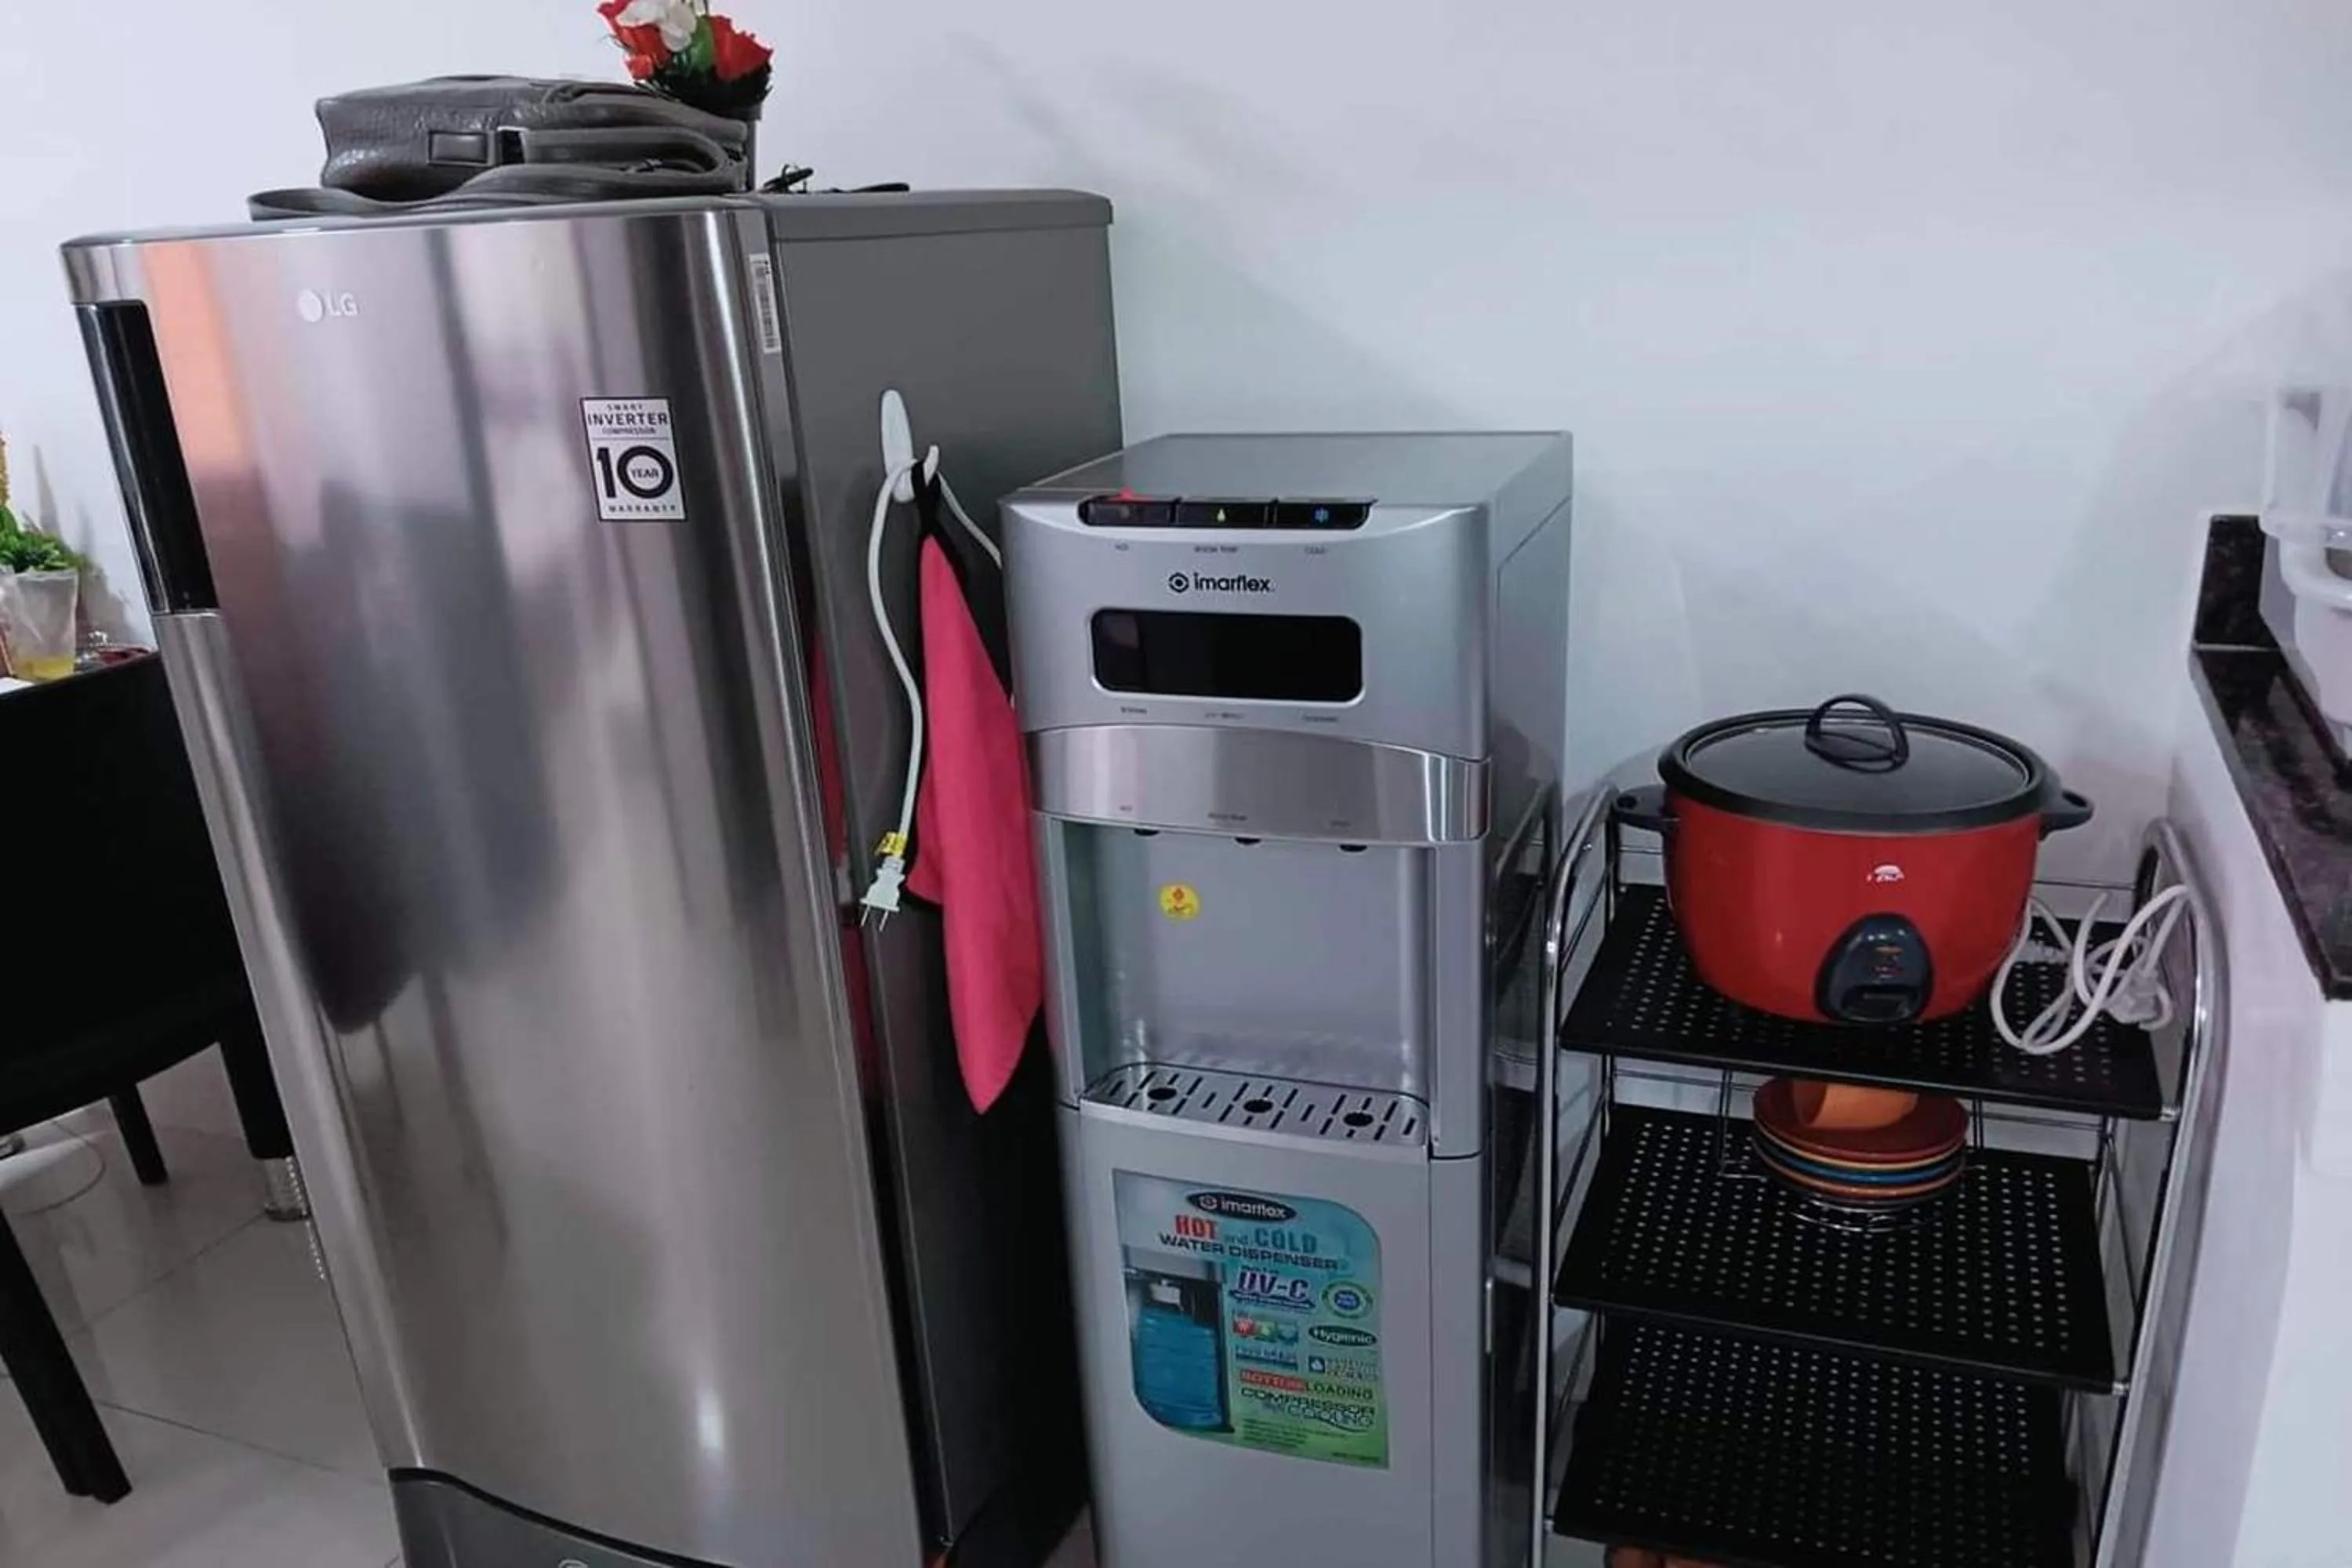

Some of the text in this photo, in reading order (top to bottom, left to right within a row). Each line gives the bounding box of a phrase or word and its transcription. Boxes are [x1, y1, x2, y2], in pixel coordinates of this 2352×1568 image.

[328, 291, 359, 316] LG
[588, 412, 669, 426] INVERTER
[597, 445, 673, 499] 10
[630, 469, 659, 479] YEAR
[1193, 572, 1271, 592] imarflex
[1221, 1196, 1287, 1218] imarflex
[1174, 1214, 1219, 1240] HOT
[1255, 1227, 1319, 1254] COLD
[1158, 1232, 1225, 1254] WATER
[1228, 1244, 1340, 1270] DISPENSER
[1305, 1381, 1374, 1400] LOADING
